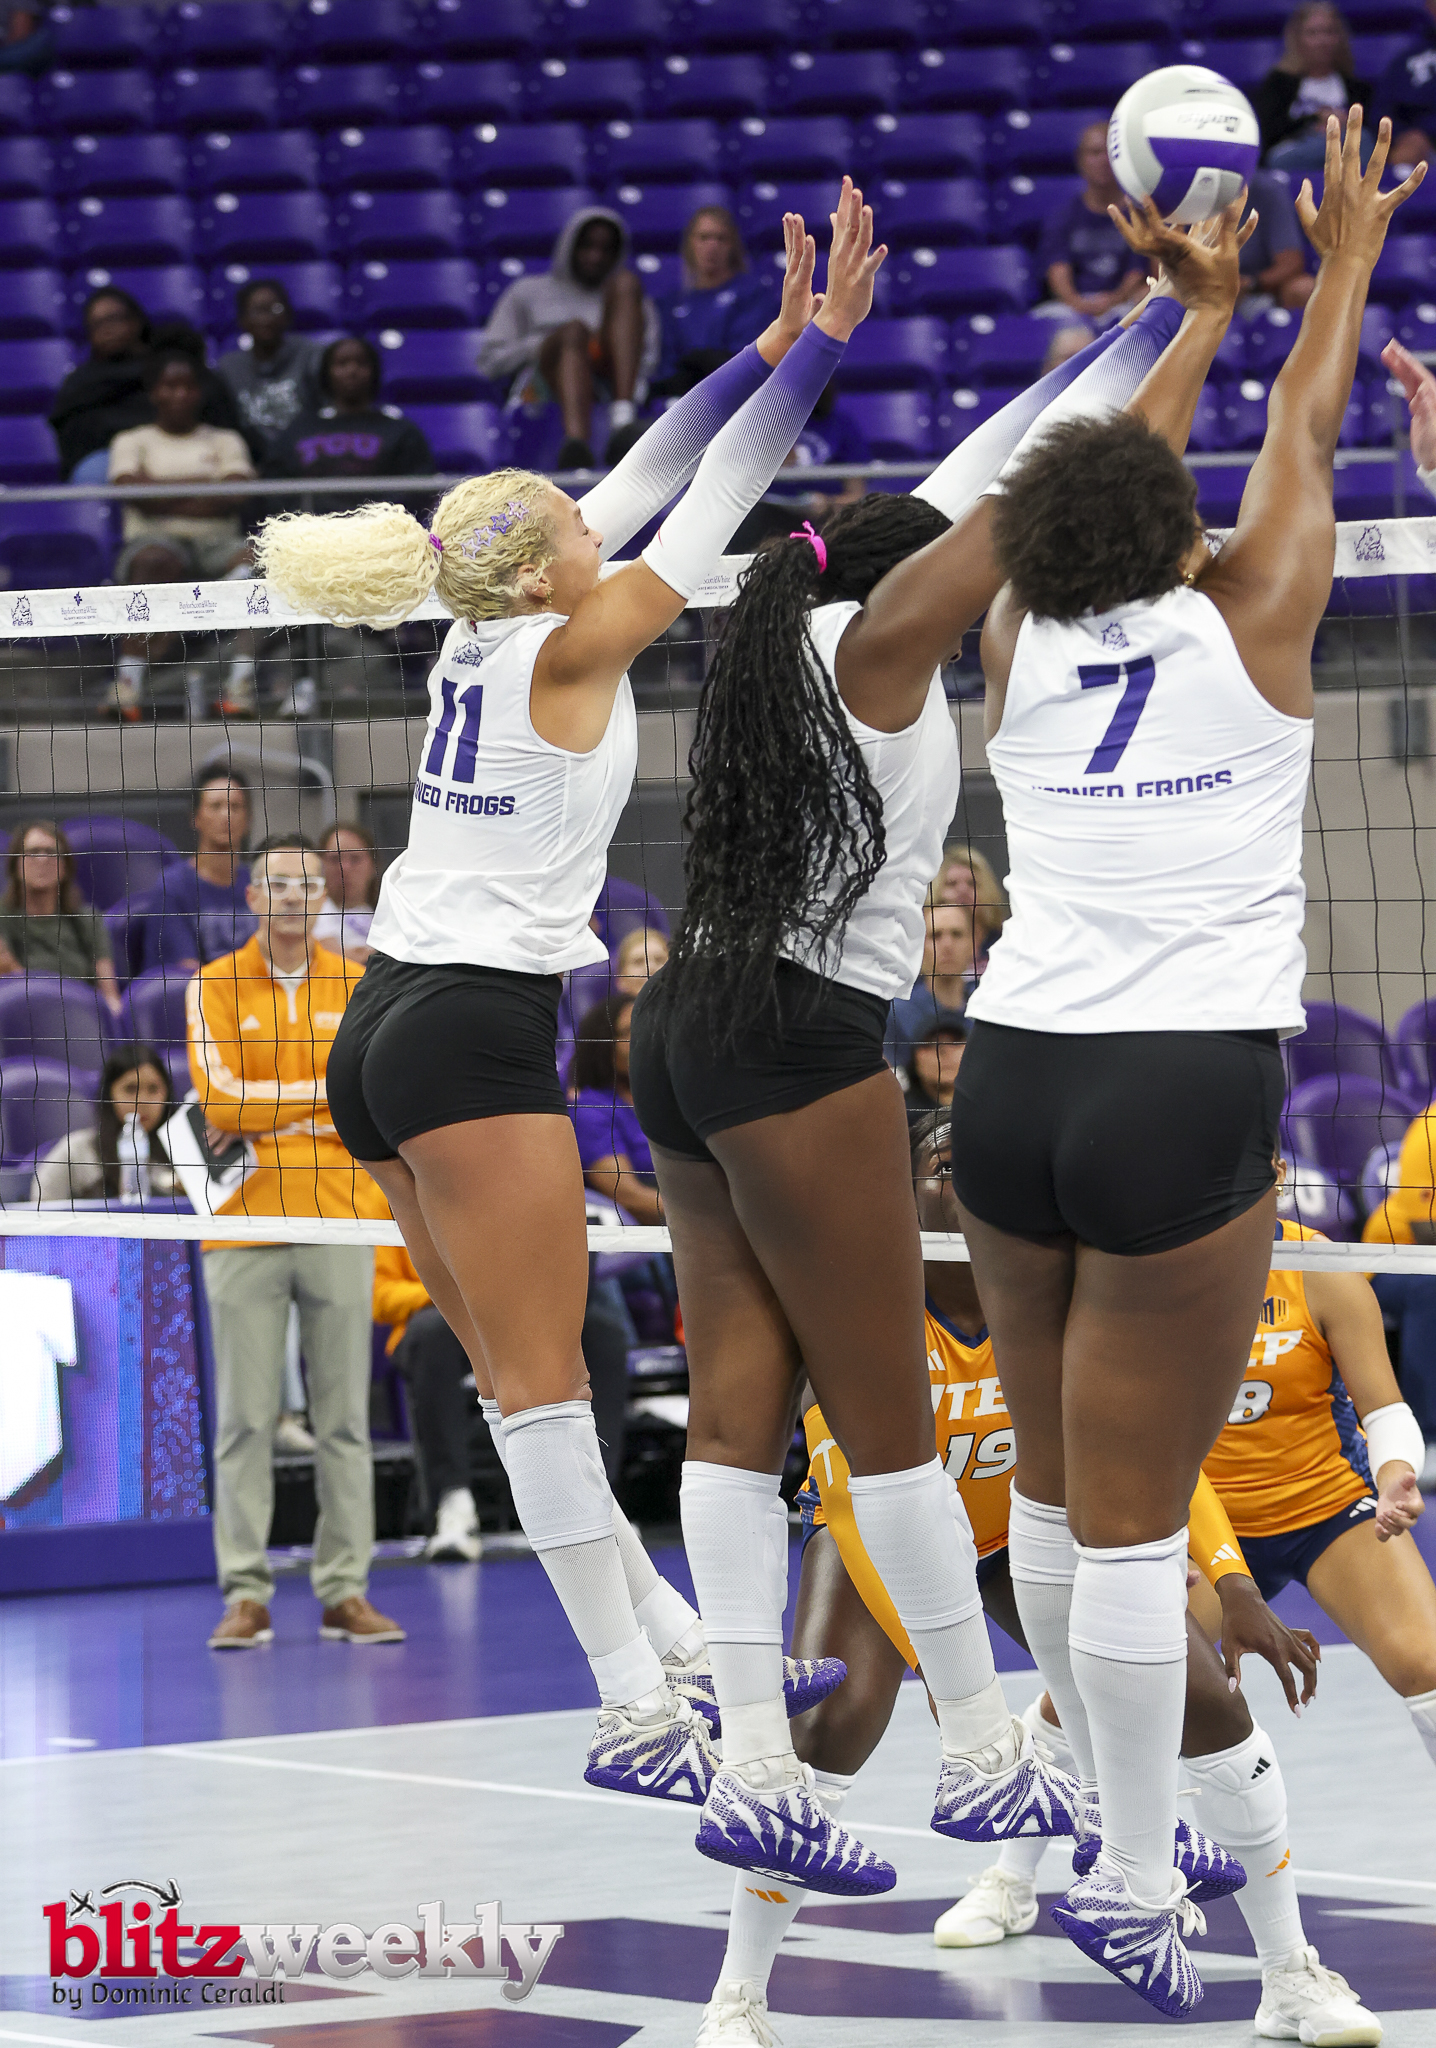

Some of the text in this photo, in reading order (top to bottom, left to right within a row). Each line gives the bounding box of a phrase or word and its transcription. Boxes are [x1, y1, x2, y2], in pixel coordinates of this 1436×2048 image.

[425, 677, 483, 784] 11
[1077, 655, 1156, 775] 7
[445, 790, 516, 816] FROGS
[943, 1427, 1017, 1480] 19
